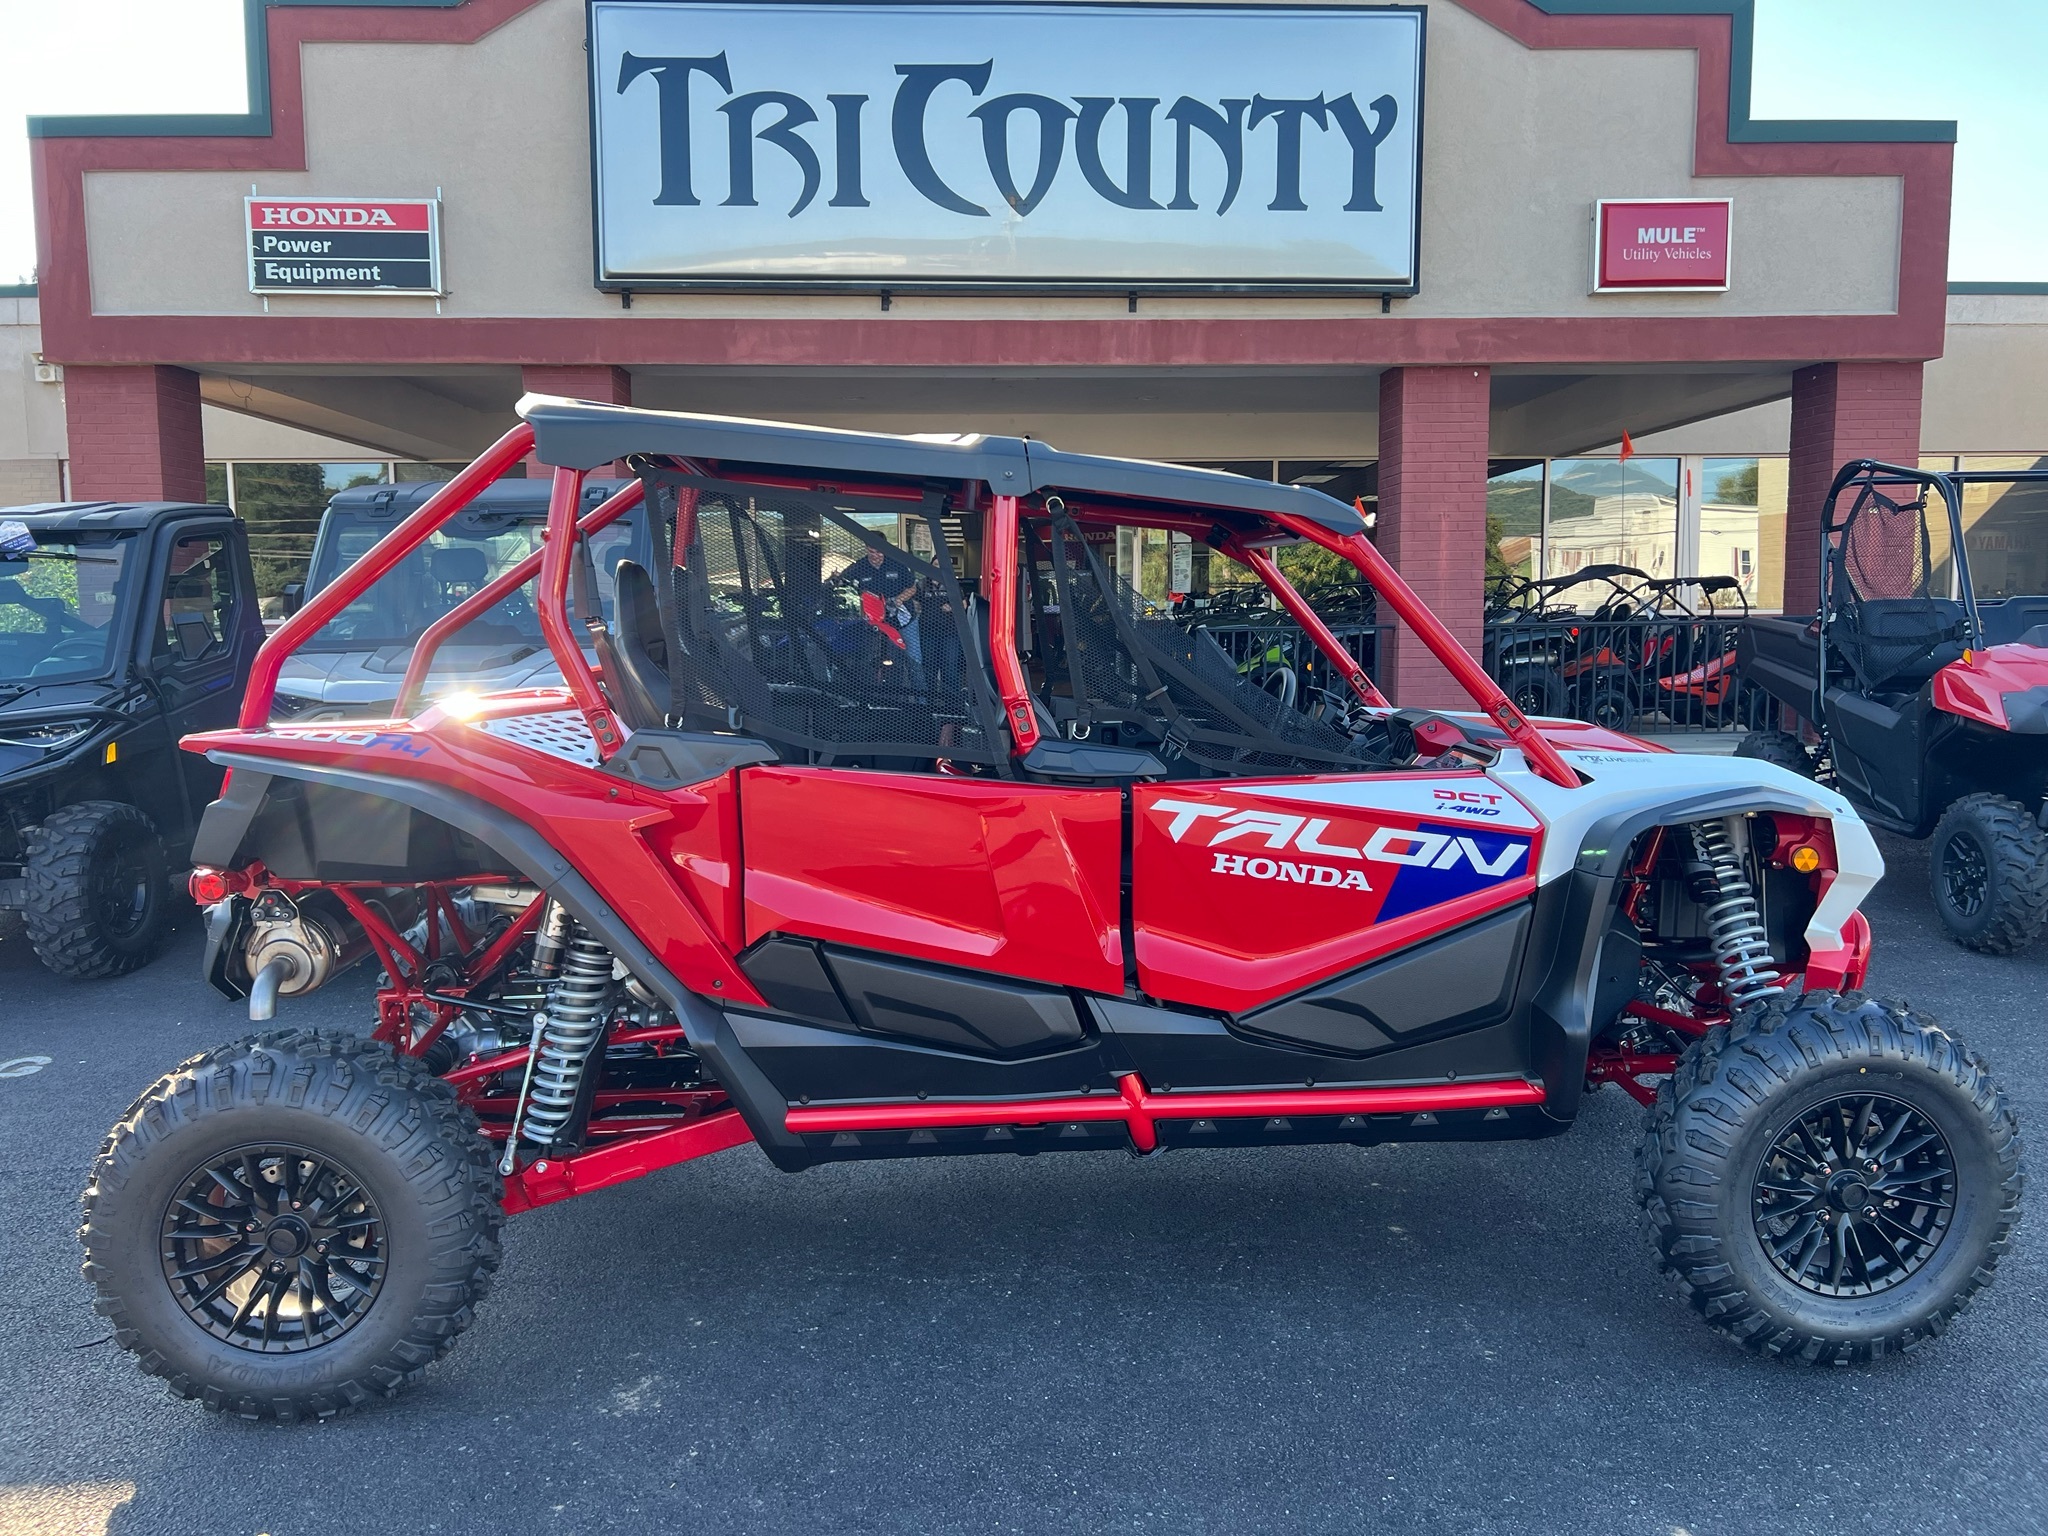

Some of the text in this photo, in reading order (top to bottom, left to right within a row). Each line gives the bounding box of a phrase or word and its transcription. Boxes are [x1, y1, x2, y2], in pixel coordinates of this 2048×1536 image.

[261, 207, 397, 226] HONDA
[263, 235, 332, 253] Power
[1623, 247, 1712, 262] Utility Vehicles
[265, 262, 381, 284] Equipment
[1433, 789, 1503, 805] DCT
[1436, 802, 1501, 816] i-4WD
[1149, 798, 1529, 877] TALON
[1211, 853, 1373, 892] HONDA
